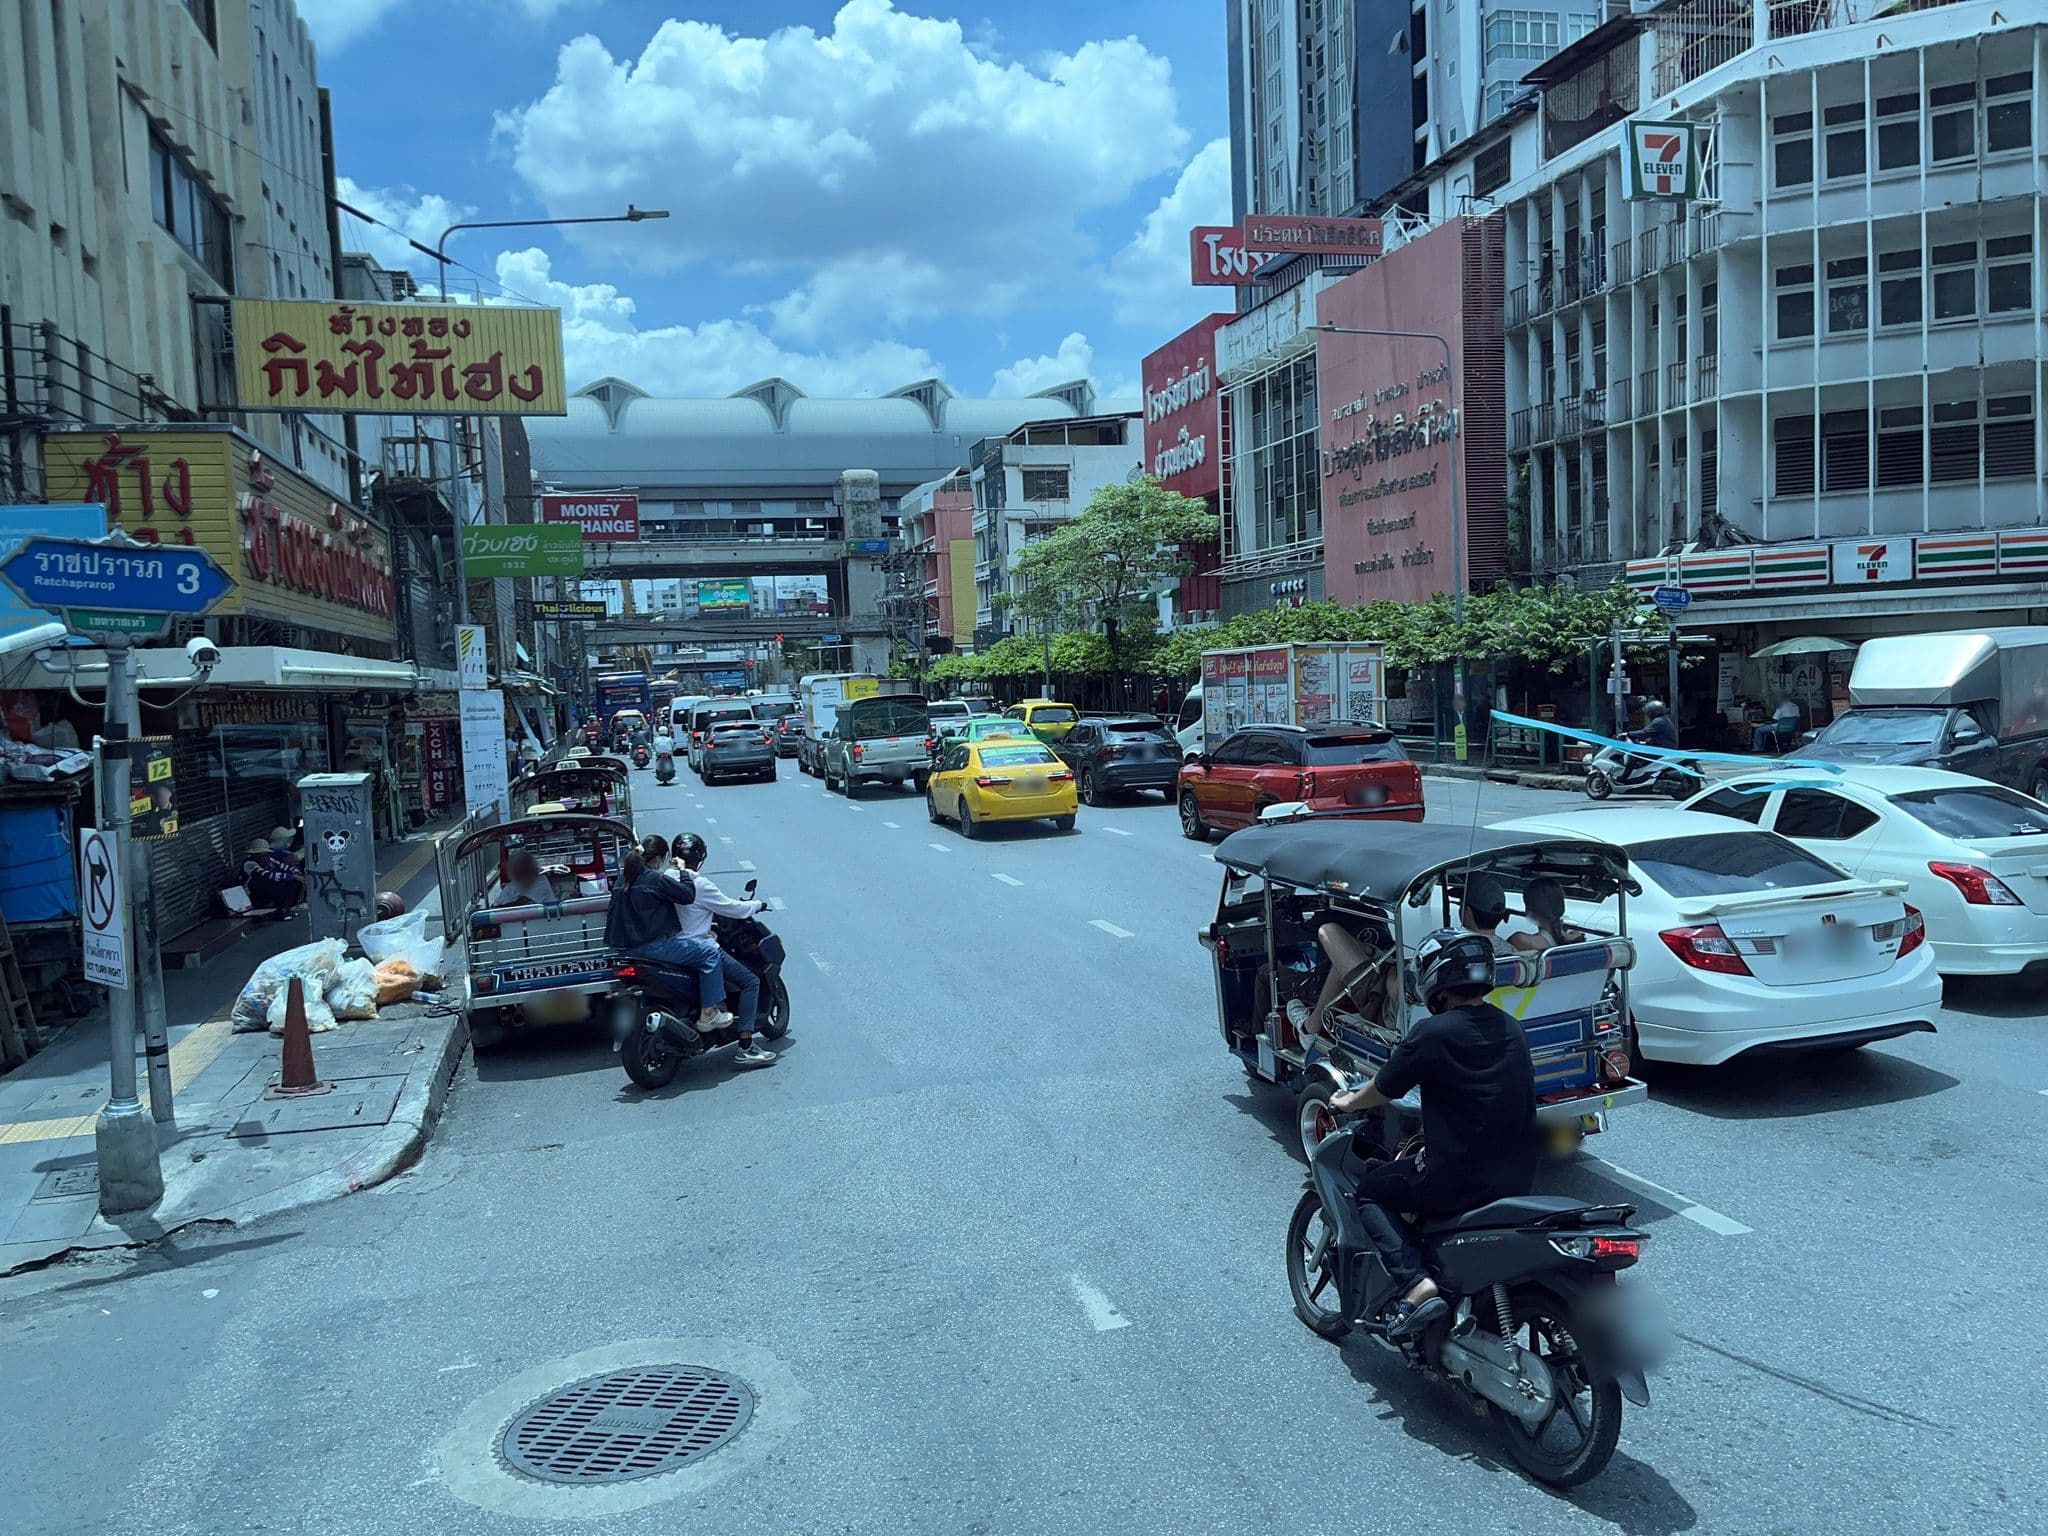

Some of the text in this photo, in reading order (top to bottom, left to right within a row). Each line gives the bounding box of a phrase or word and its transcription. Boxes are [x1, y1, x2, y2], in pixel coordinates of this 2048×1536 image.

[1643, 162, 1683, 176] ELEVEN
[328, 306, 472, 338] ห้างทอง
[260, 332, 545, 402] กิมไท้เฮง
[560, 504, 620, 517] MONEY
[549, 520, 635, 533] HANGE
[503, 561, 526, 569] 1932
[1856, 561, 1888, 570] ELEVEN
[34, 551, 200, 594] ราชปรารภ 3
[34, 576, 115, 590] Ratchaprarop
[151, 762, 169, 779] 12
[510, 957, 609, 981] THAILAND
